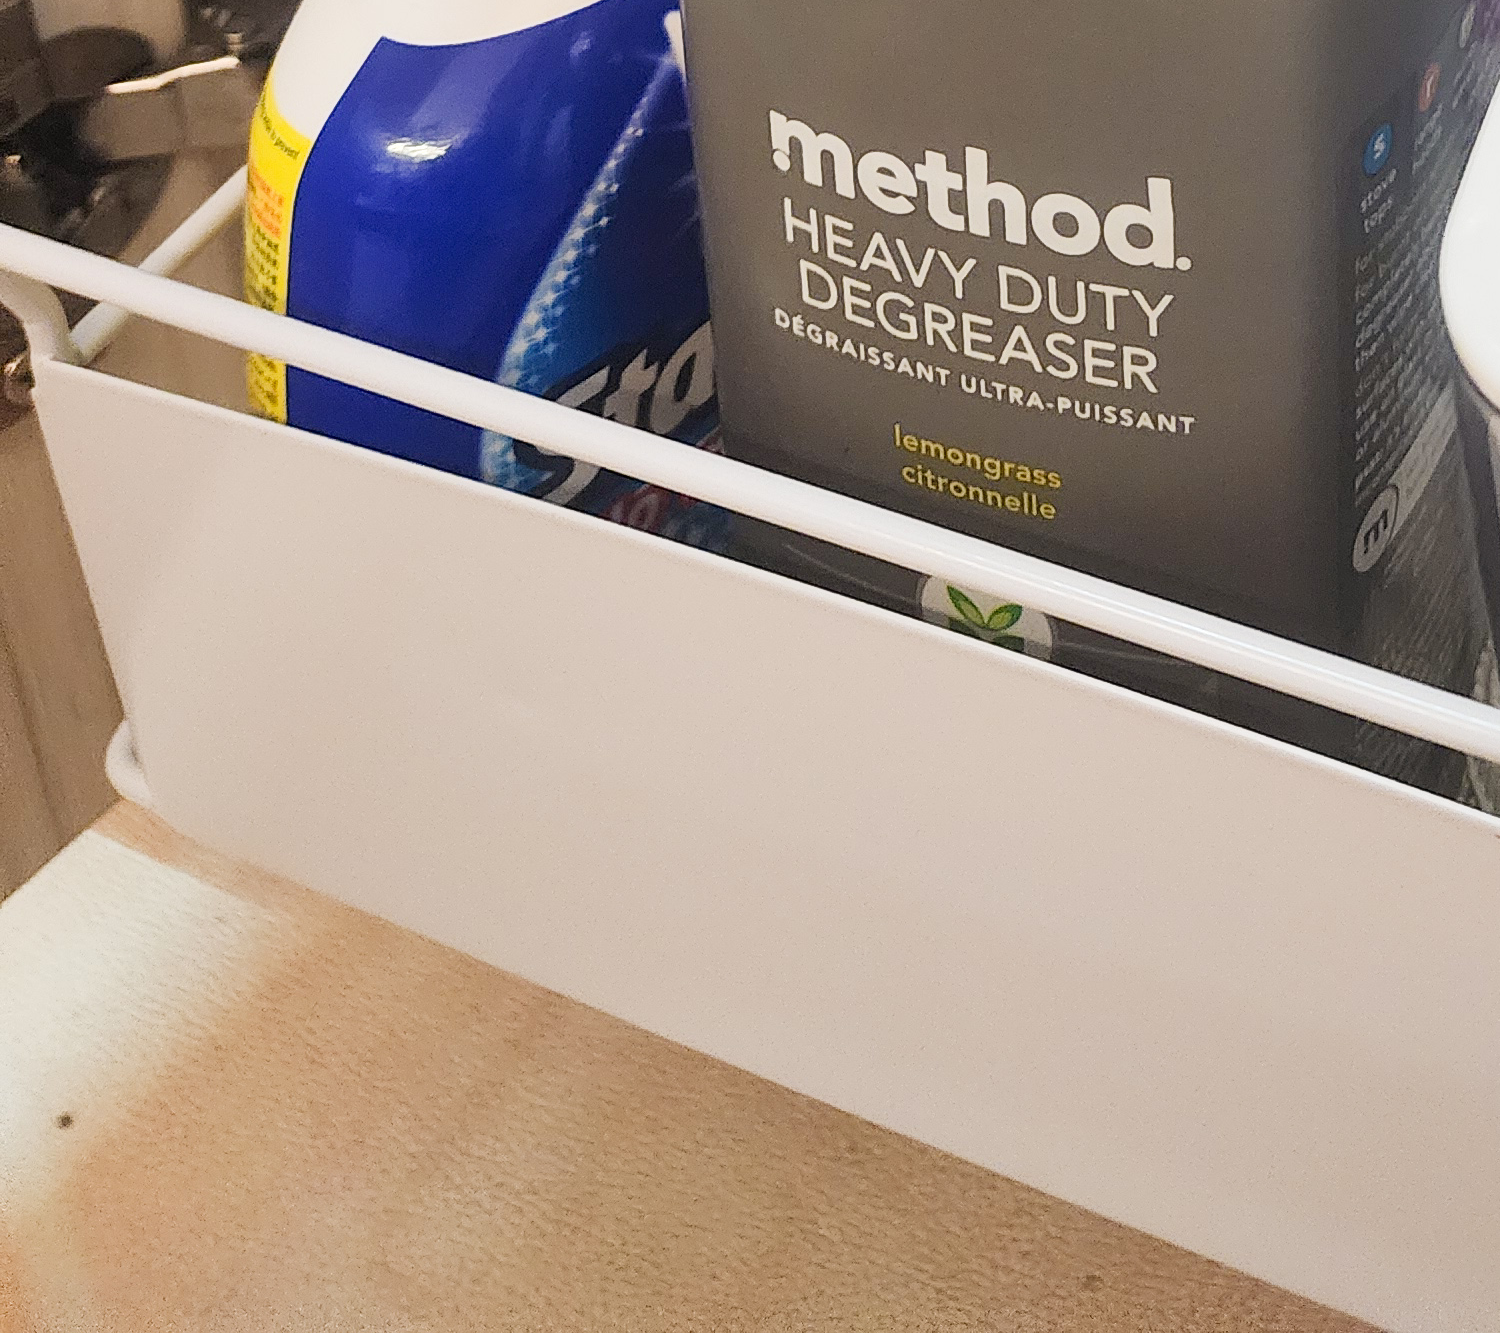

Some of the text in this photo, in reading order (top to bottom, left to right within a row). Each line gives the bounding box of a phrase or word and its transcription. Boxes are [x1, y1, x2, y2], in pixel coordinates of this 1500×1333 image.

[782, 197, 1174, 338] HEAVY DUTY
[799, 259, 1158, 394] DEGREASER
[773, 307, 1196, 436] DÉGRAISSANT ULTRA-PUISSANT
[892, 423, 1062, 491] lemongrass
[901, 462, 1057, 521] citronnelle
